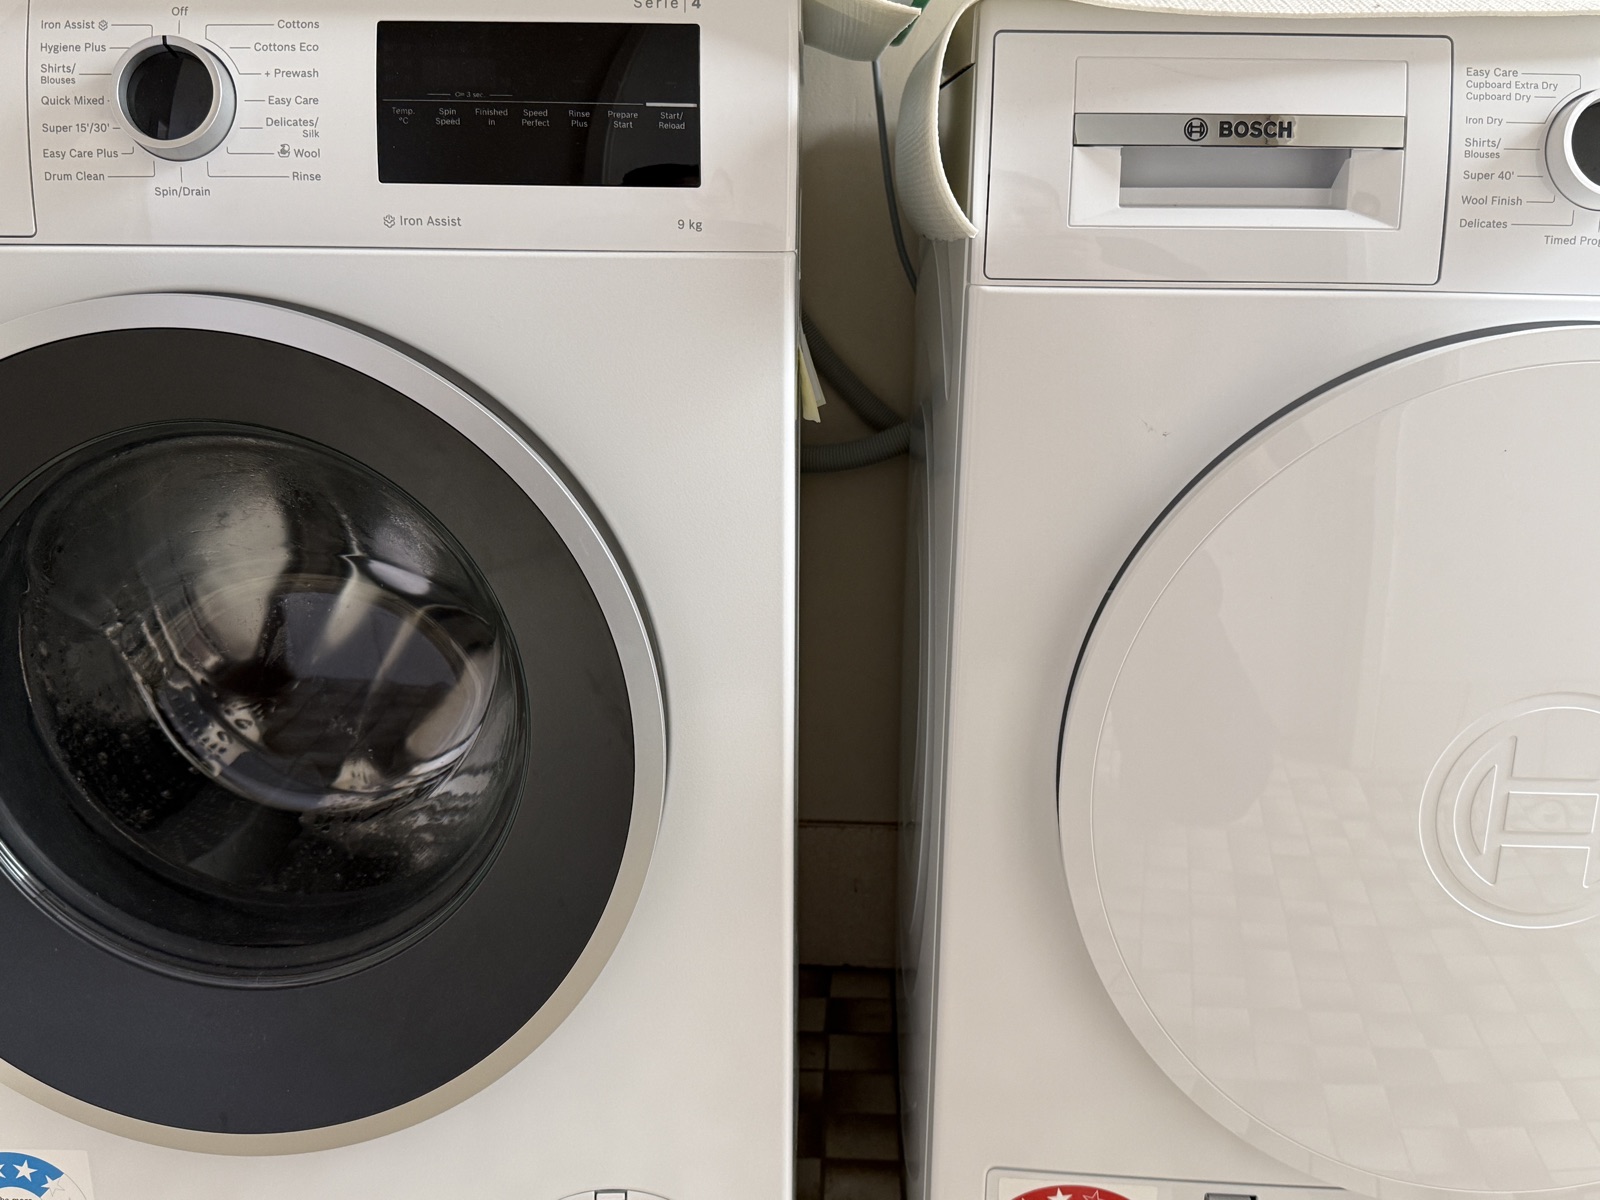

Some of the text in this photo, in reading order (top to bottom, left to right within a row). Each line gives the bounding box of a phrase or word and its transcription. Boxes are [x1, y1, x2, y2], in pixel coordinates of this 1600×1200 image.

[633, 0, 679, 9] Serie
[171, 6, 189, 16] Off
[40, 20, 95, 30] Iron Assist
[277, 19, 320, 29] Cottons
[40, 42, 107, 54] Hygiene Plus
[253, 42, 320, 52] Cottons Eco
[40, 62, 76, 74] Shirts/
[274, 68, 319, 78] Prewash
[1466, 67, 1519, 79] Easy Care
[40, 75, 76, 85] Blouses
[1465, 80, 1559, 92] Cupboard Extra Dry
[41, 96, 105, 106] Quick Mixed
[268, 95, 319, 107] Easy Care
[1465, 91, 1532, 103] Cupboard Dry
[391, 106, 416, 116] Temp.
[438, 107, 457, 117] Spin
[475, 107, 509, 117] Finished
[523, 108, 549, 118] Speed
[568, 109, 591, 118] Rinse
[607, 110, 639, 120] Prepare
[660, 111, 684, 121] Start/
[265, 116, 319, 128] Delicates/
[435, 117, 461, 127] Speed
[521, 118, 550, 128] Perfect
[571, 119, 588, 128] Plus
[613, 120, 633, 129] Start
[658, 121, 686, 130] Reload
[1465, 115, 1504, 127] Iron Dry
[42, 123, 73, 134] Super
[302, 129, 320, 138] Silk
[1218, 120, 1293, 139] BOSCH
[1464, 137, 1502, 149] Shirts/
[42, 148, 119, 160] Easy Care Plus
[293, 148, 321, 158] Wool
[1464, 149, 1501, 159] Blouses
[44, 171, 105, 181] Drum Clean
[292, 171, 322, 181] Rinse
[1463, 170, 1515, 182] Super 40'
[154, 186, 211, 198] Spin/Drain
[1461, 195, 1523, 206] Wool Finish
[399, 215, 462, 227] Iron Assist
[677, 218, 703, 233] 9 kg
[1459, 218, 1508, 229] Delicates
[1544, 234, 1577, 246] Timed
